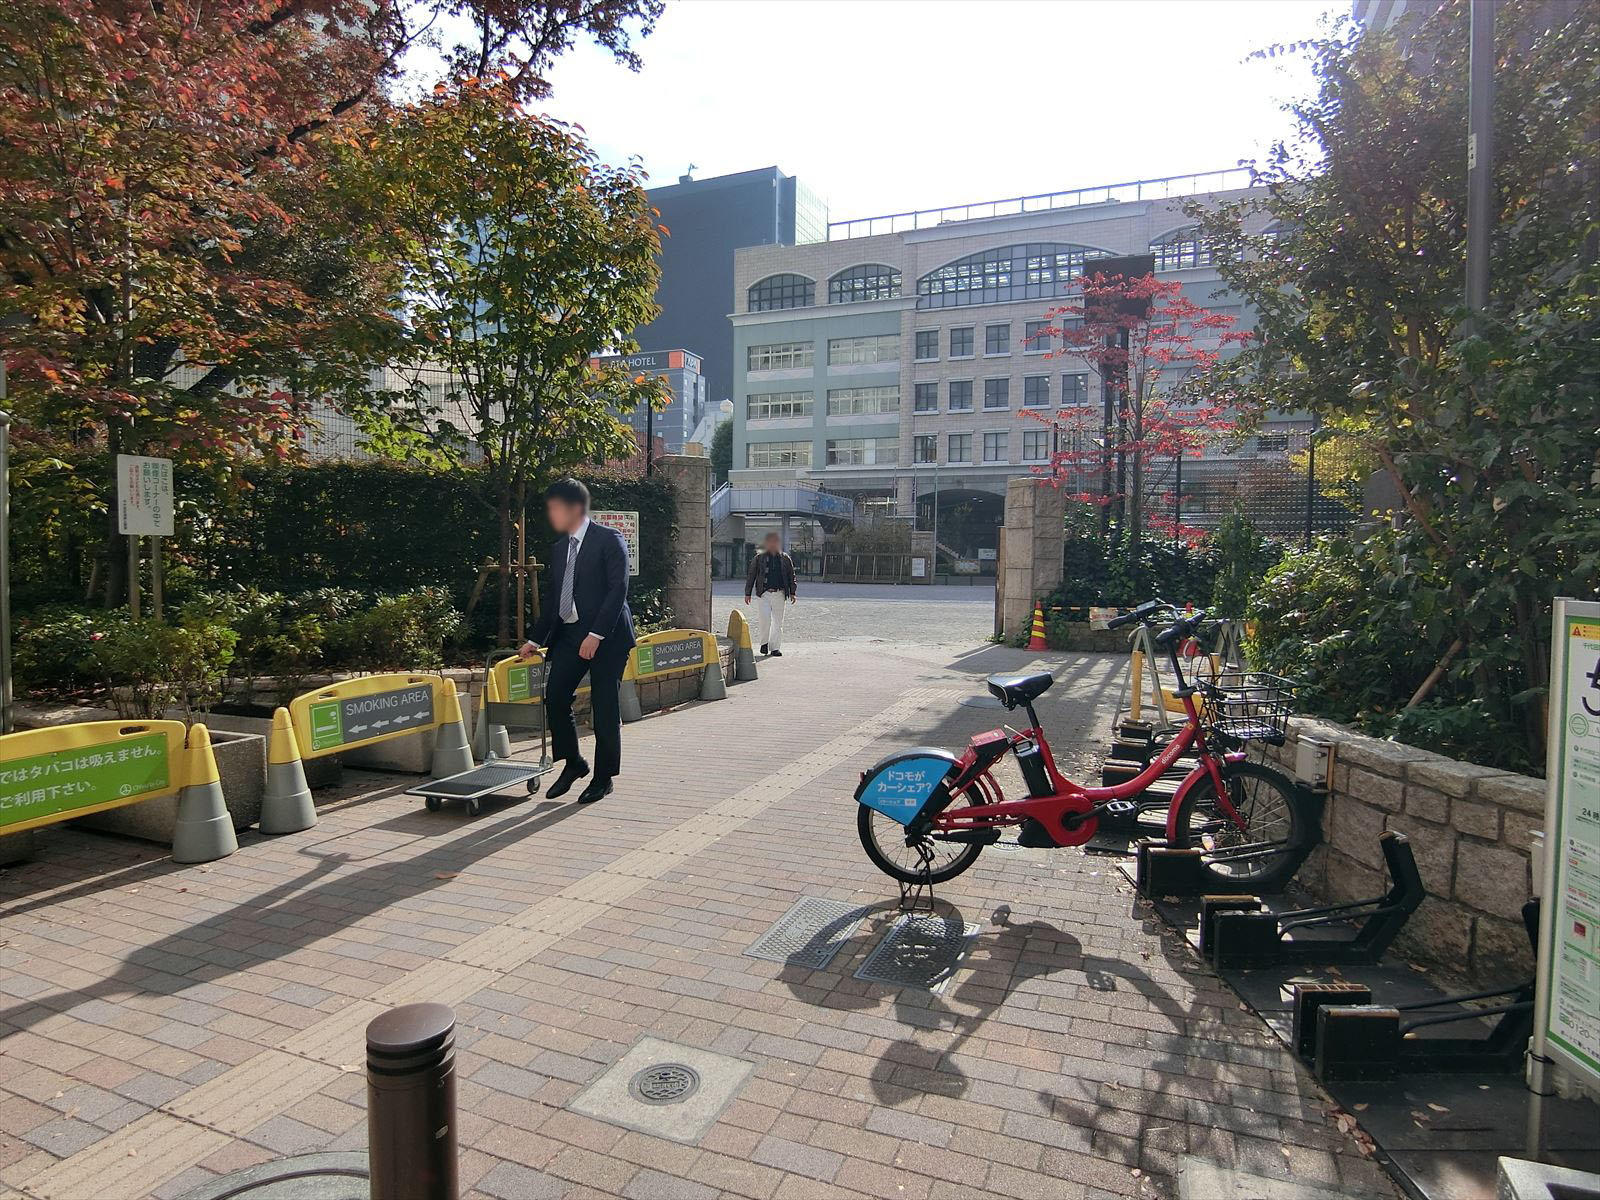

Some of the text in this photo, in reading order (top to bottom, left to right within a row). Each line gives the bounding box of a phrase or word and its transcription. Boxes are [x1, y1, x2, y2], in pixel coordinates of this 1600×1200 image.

[628, 357, 657, 367] HOTEL
[656, 640, 701, 655] SMOKING AREA
[345, 690, 429, 716] SMOKING AREA
[1161, 744, 1181, 765] docomo
[0, 745, 162, 785] ではタバコは吸えません。
[888, 770, 926, 781] ドコモが
[0, 780, 96, 809] ご利用下さい。
[877, 781, 932, 793] カーシェア?
